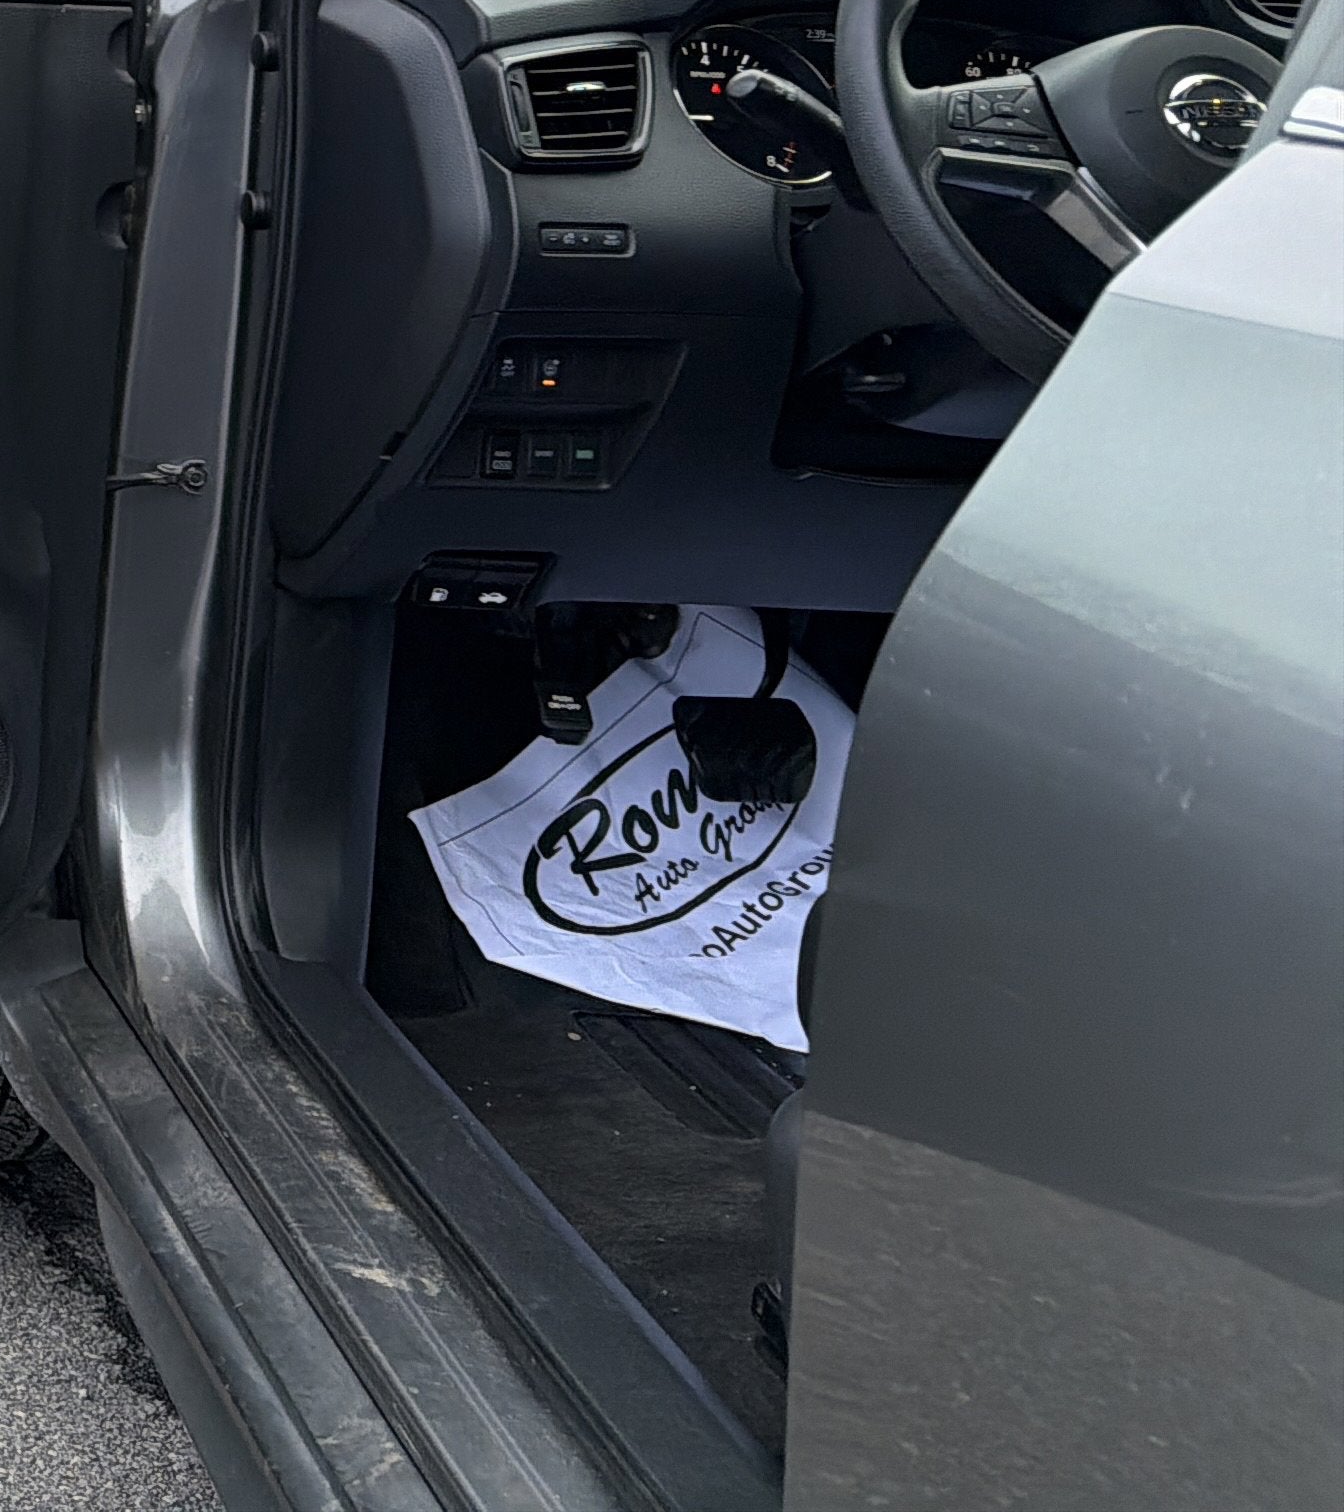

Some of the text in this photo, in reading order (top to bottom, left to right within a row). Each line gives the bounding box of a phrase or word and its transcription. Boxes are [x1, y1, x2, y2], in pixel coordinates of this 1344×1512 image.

[700, 54, 711, 66] 4
[965, 67, 981, 77] 60
[766, 155, 777, 167] 8
[536, 768, 699, 897] Rom
[634, 799, 785, 914] Auto Gro
[688, 842, 834, 959] oAutoGrou
